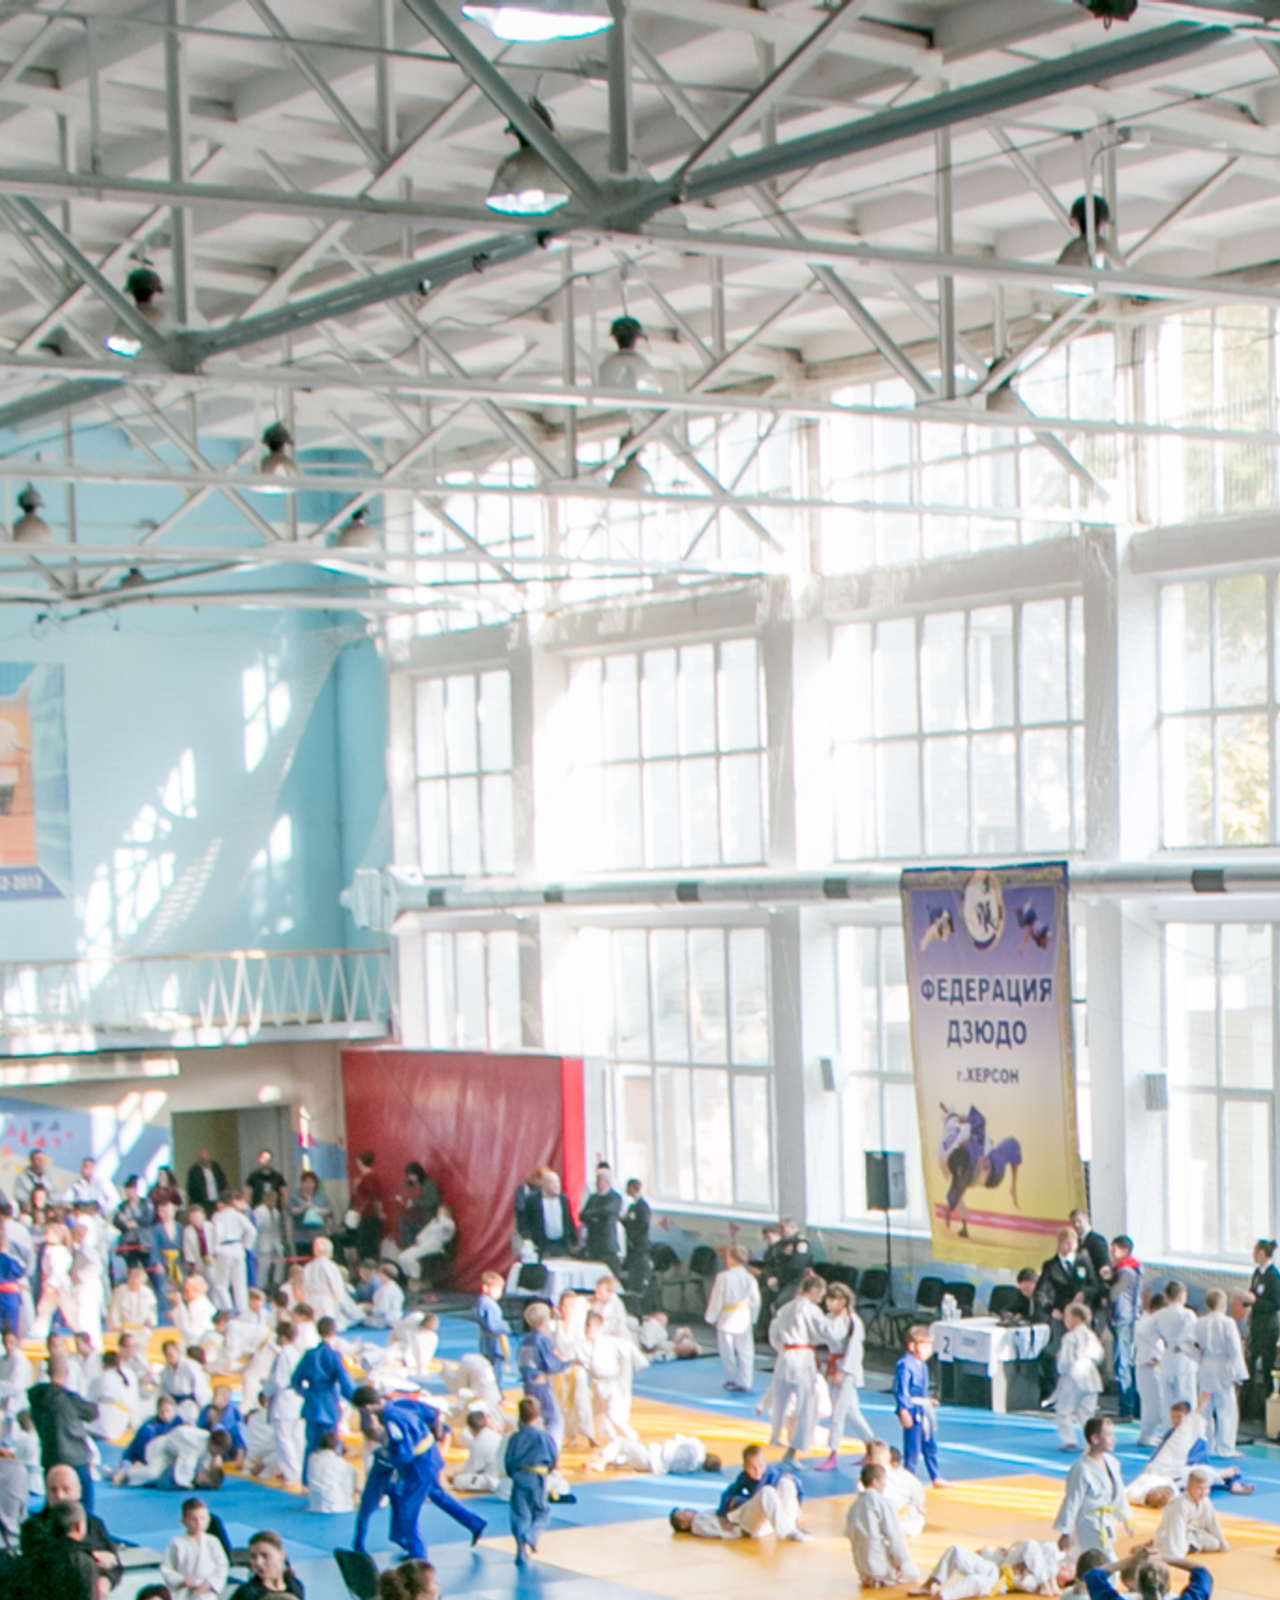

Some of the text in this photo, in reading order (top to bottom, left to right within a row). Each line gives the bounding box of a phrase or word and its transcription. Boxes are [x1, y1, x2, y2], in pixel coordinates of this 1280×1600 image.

[921, 978, 1053, 1007] ФЕДЕРАЦИЯ
[947, 1019, 1027, 1049] ДЗЮДО
[943, 1336, 950, 1354] 2
